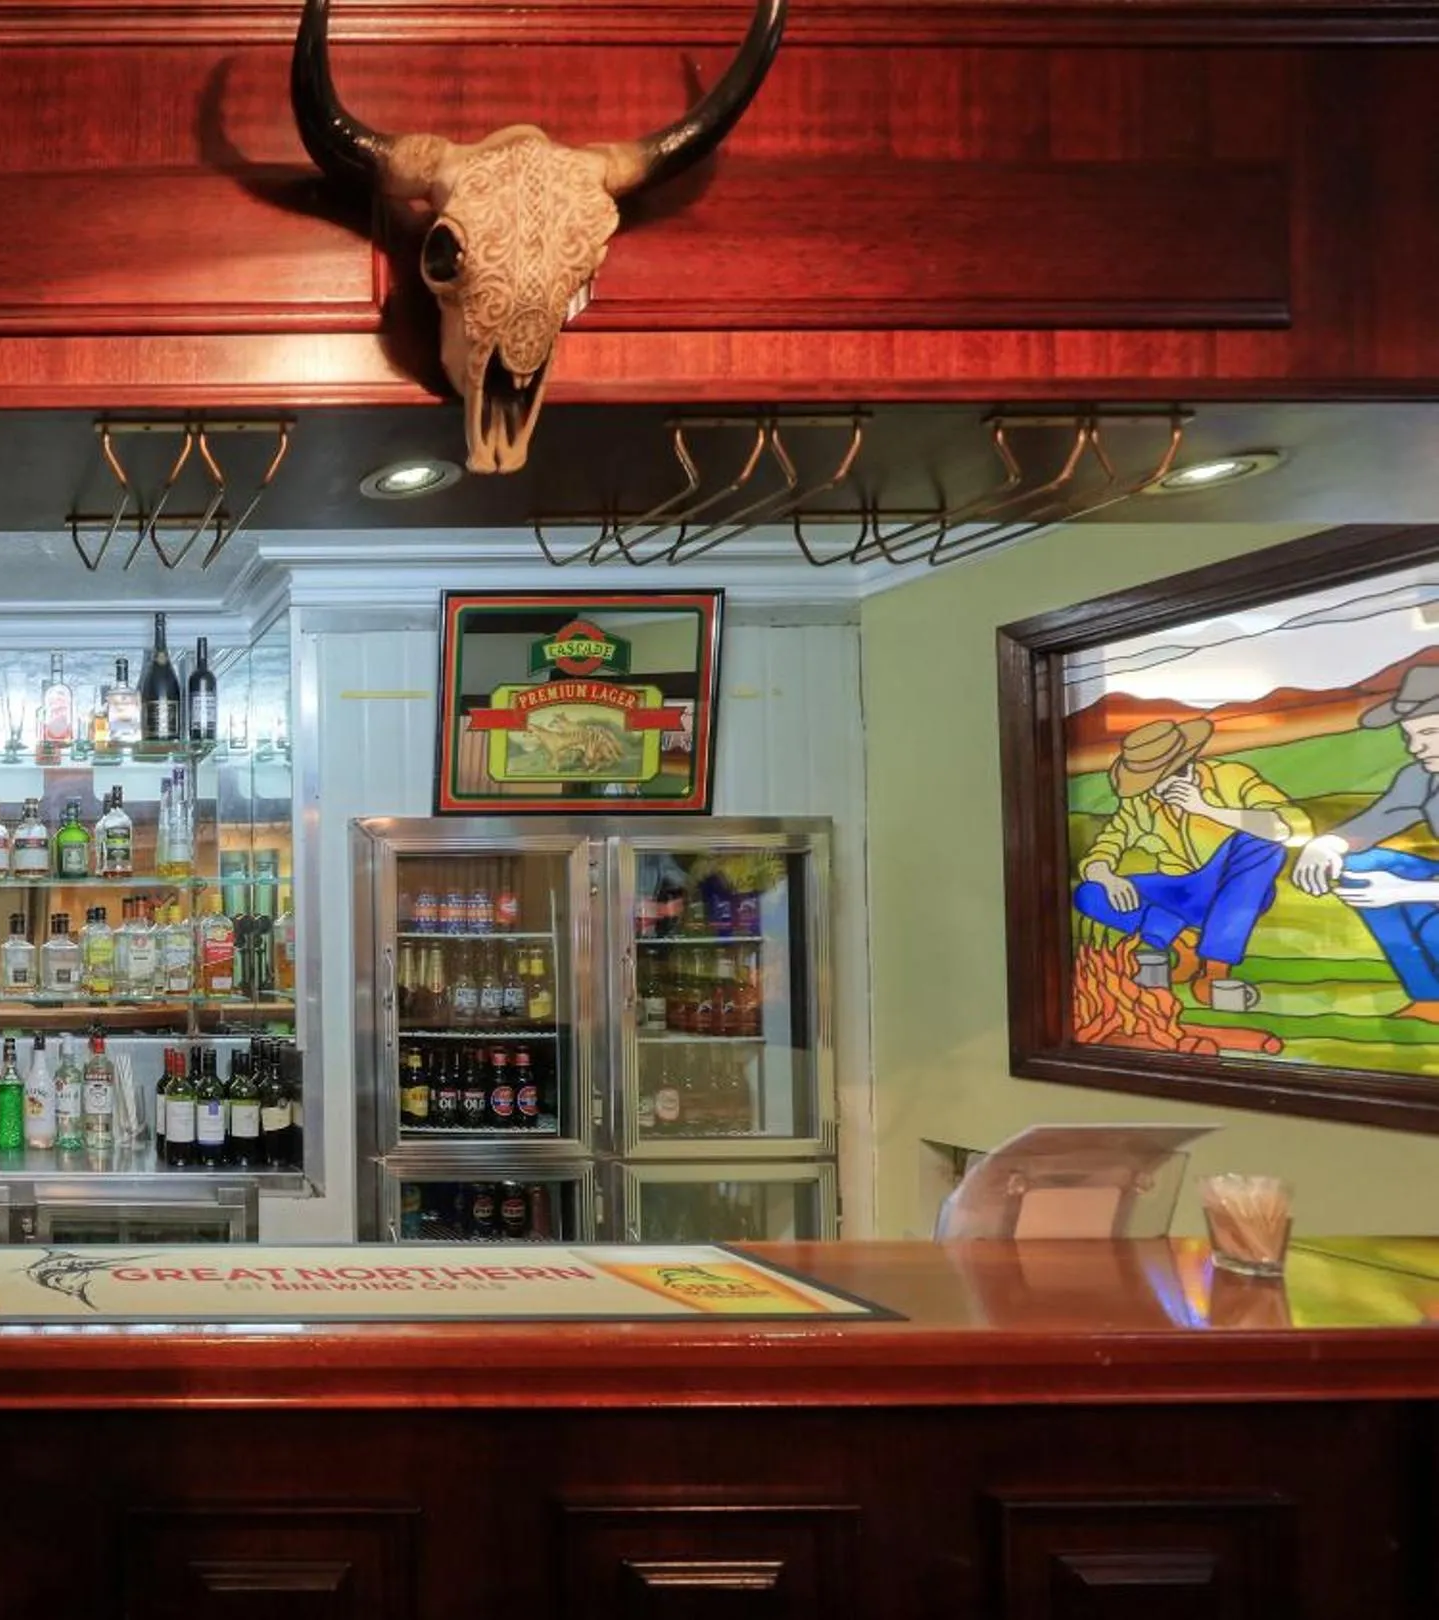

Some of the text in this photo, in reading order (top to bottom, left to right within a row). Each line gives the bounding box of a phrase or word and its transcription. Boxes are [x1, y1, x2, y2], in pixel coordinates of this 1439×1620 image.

[548, 642, 613, 657] CASCADE
[518, 684, 637, 708] PREMIUM LAGER
[271, 1282, 413, 1291] BREWING
